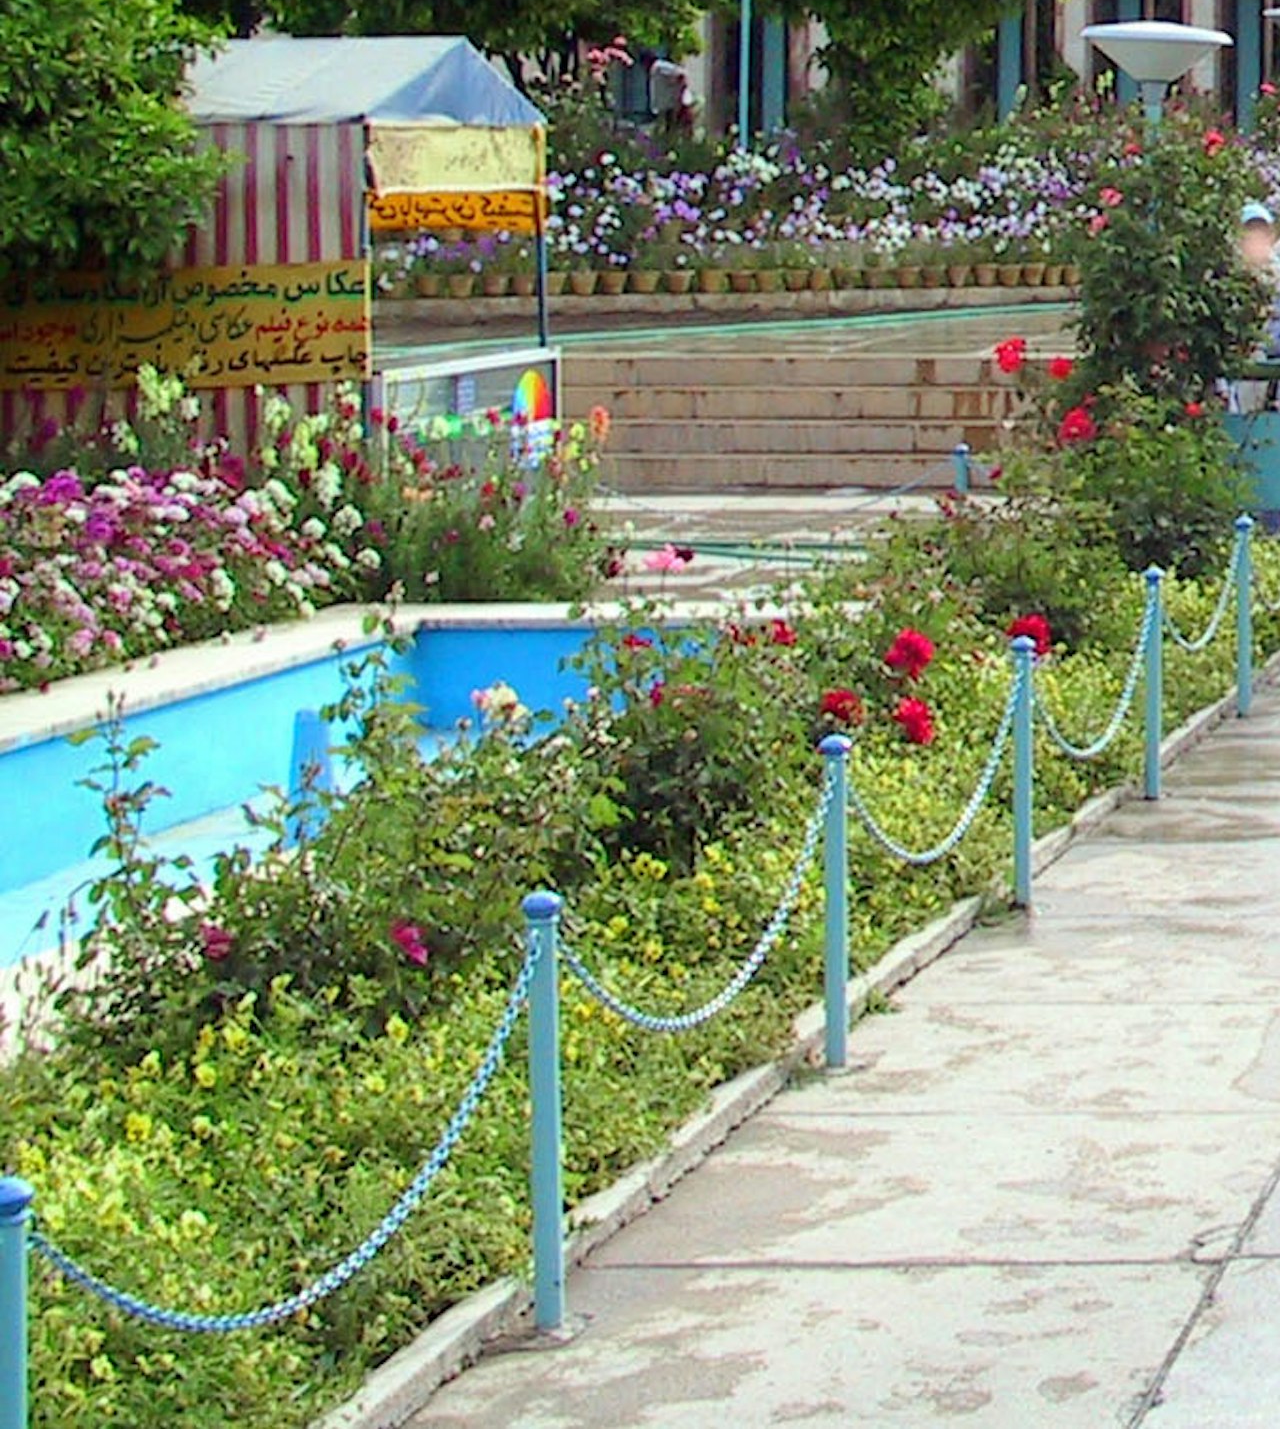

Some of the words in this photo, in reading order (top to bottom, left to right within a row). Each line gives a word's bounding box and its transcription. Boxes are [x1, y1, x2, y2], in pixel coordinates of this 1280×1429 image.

[173, 270, 277, 306] مخصوص
[284, 269, 365, 302] عکاس
[256, 307, 292, 344] فیلم
[294, 310, 328, 343] نوع
[319, 344, 367, 373] چاپ
